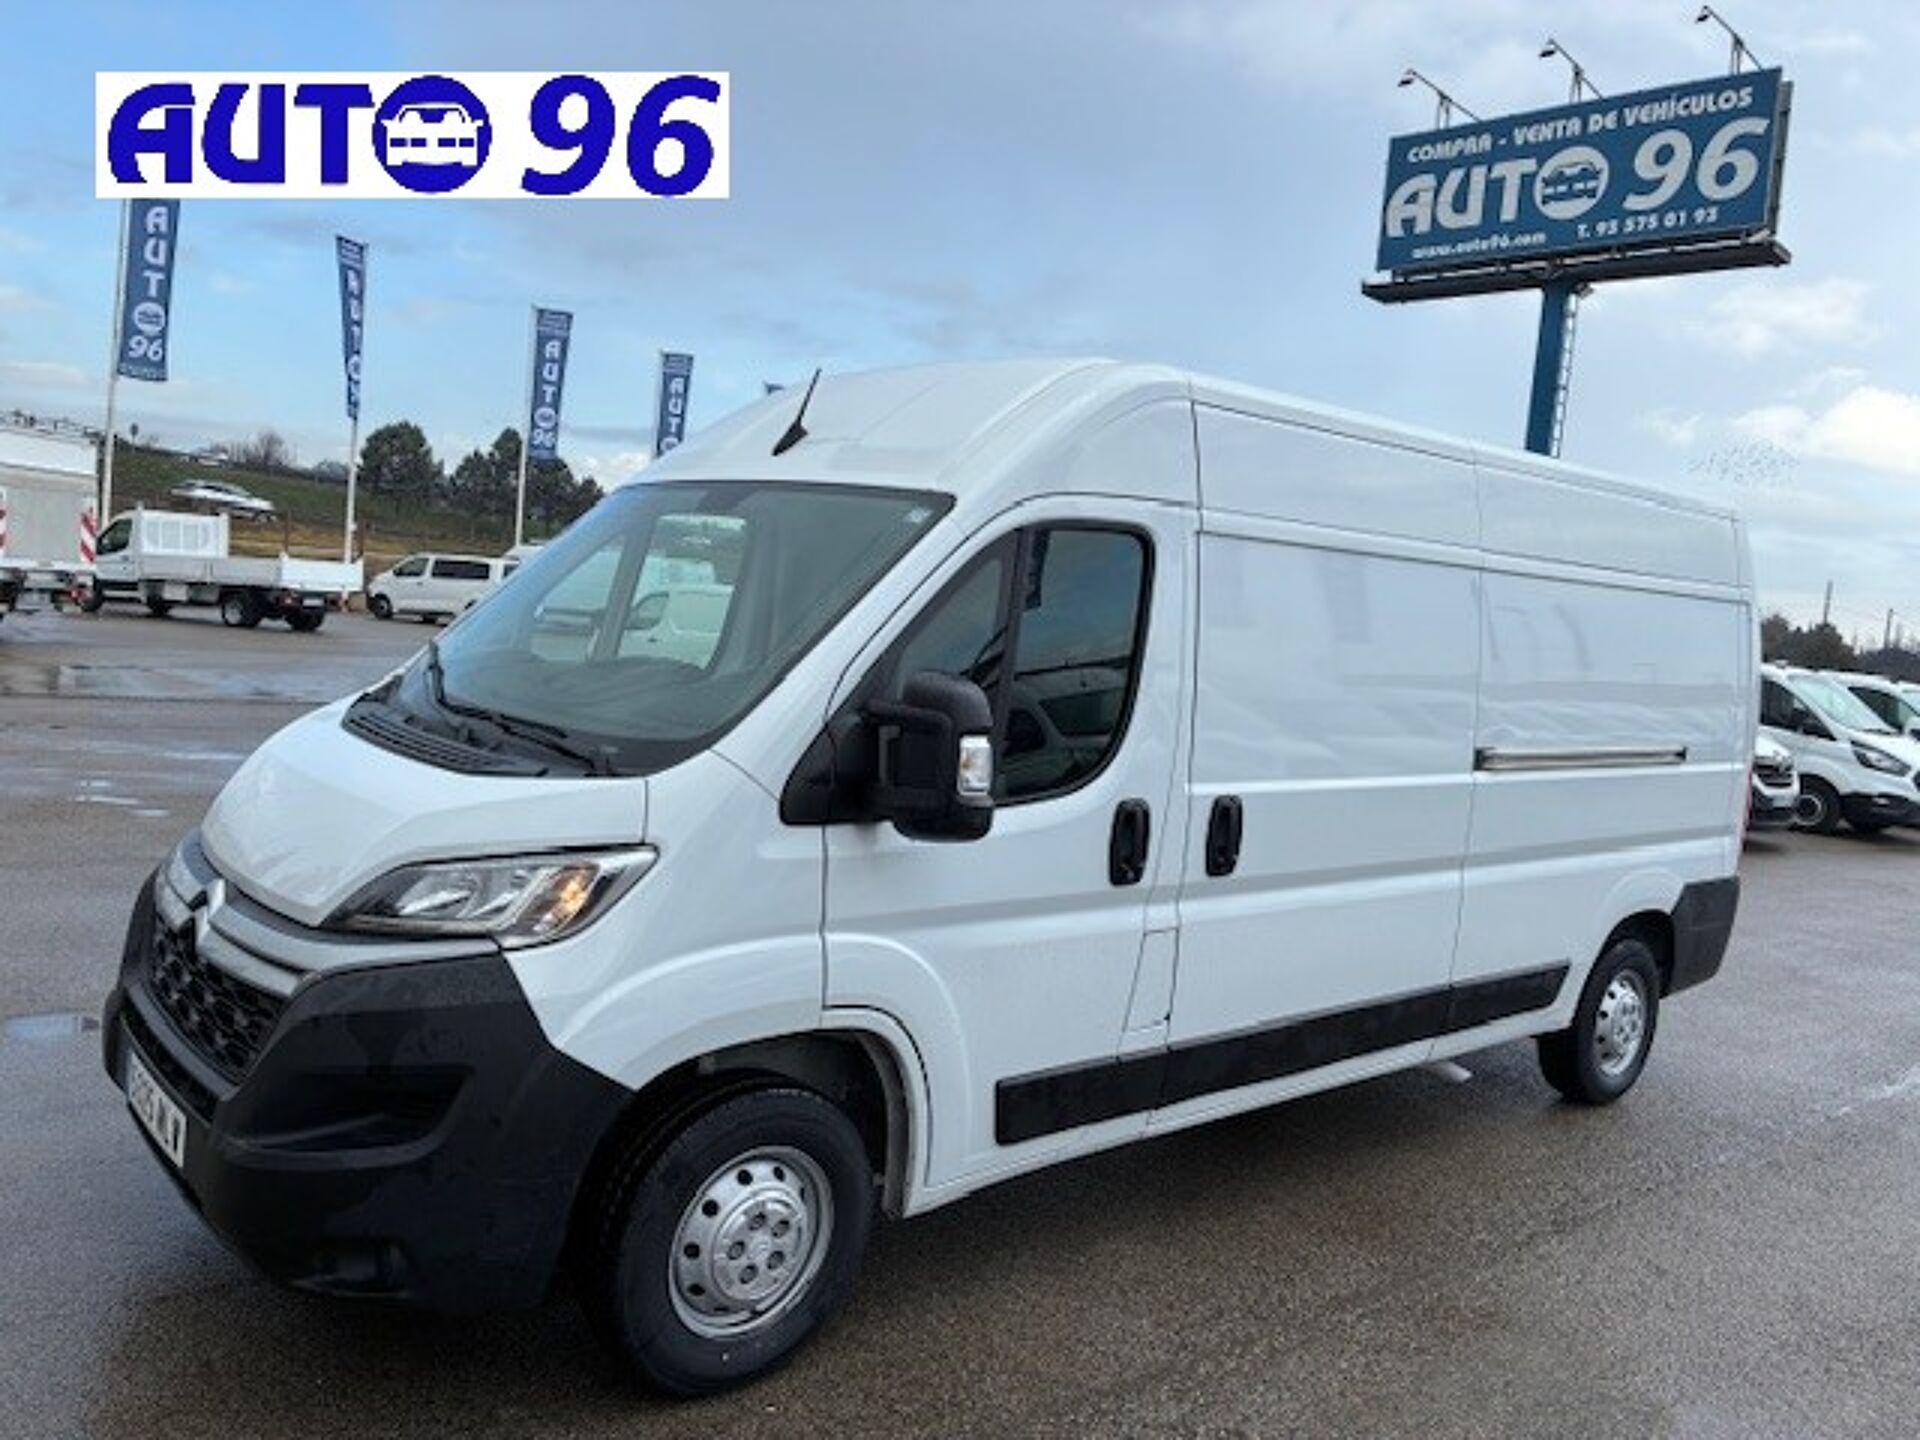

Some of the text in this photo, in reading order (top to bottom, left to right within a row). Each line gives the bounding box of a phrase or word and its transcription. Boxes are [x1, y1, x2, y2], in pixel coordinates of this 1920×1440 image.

[1407, 132, 1492, 163] COMPRA
[1513, 117, 1582, 146] VENTA
[1587, 110, 1618, 133] DE
[1623, 87, 1753, 127] VEHÍCULOS
[1385, 116, 1771, 237] AUTO 96
[133, 206, 168, 336] AUTO
[128, 335, 163, 361] 96
[534, 340, 561, 429] AUTO
